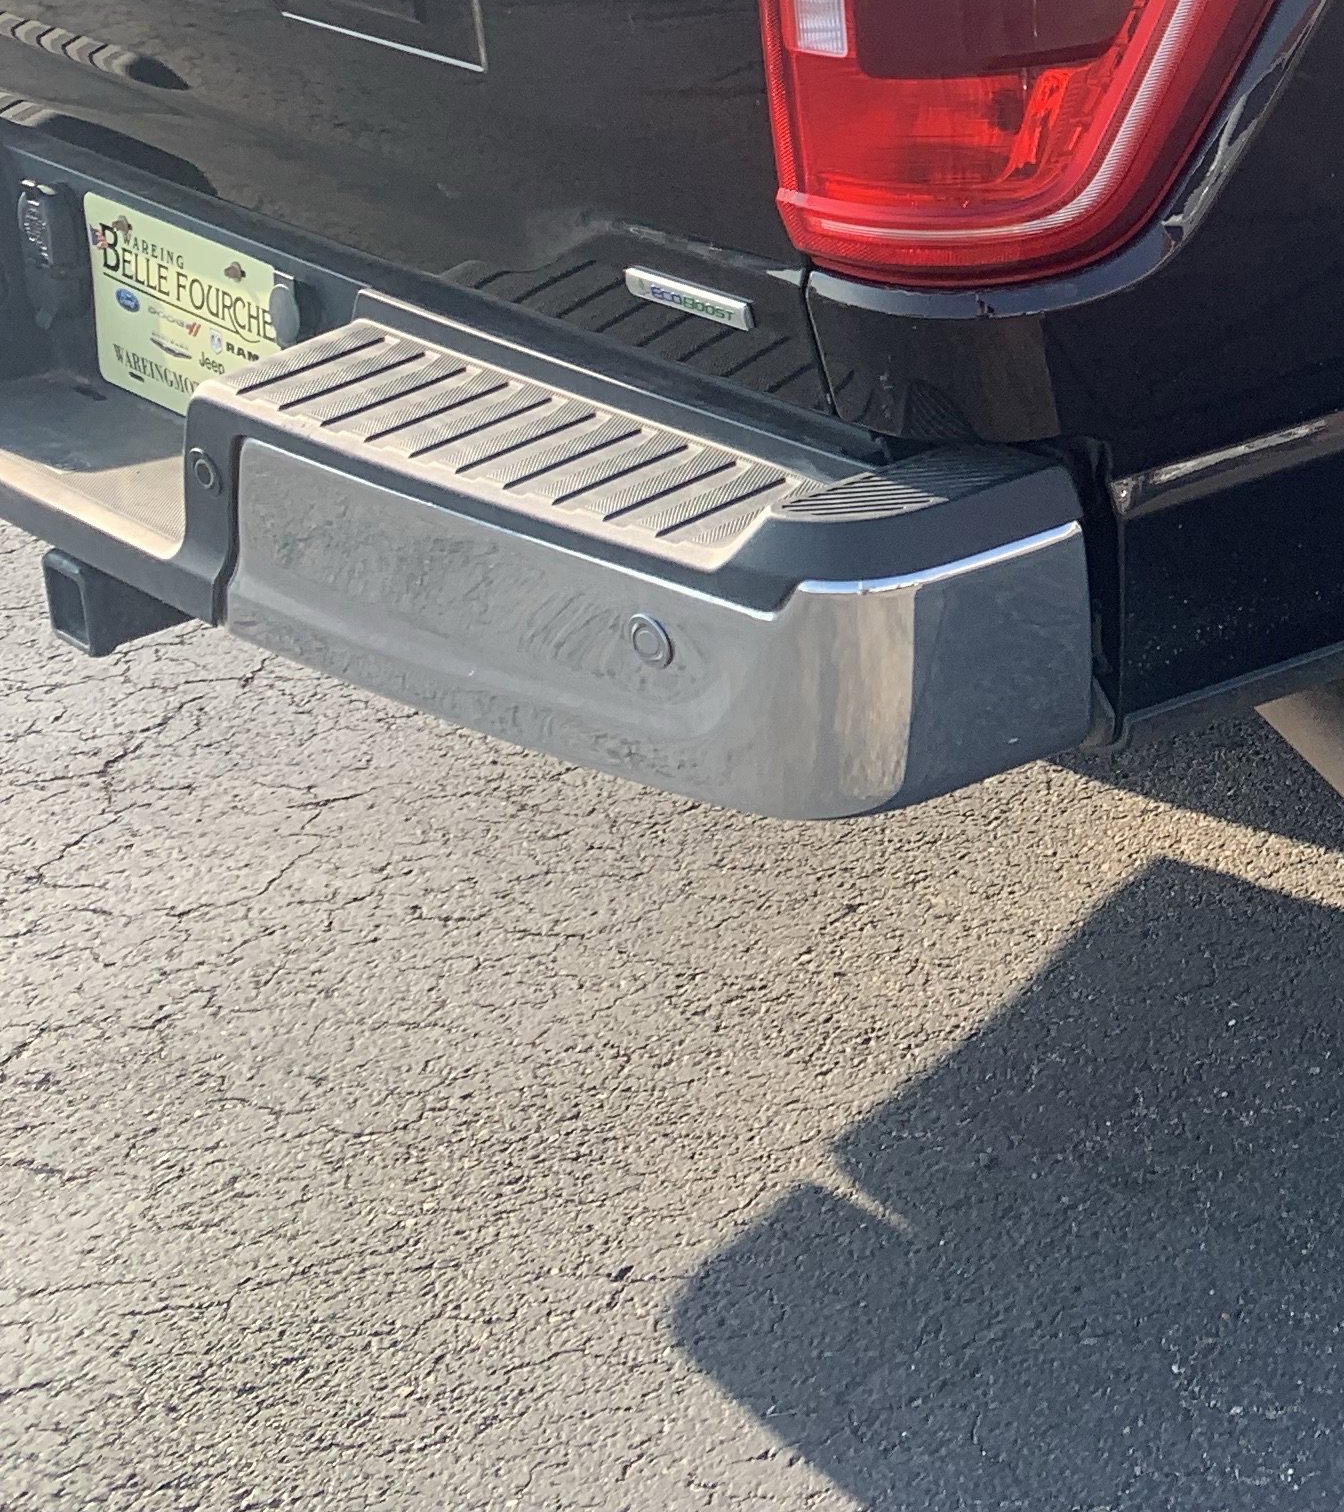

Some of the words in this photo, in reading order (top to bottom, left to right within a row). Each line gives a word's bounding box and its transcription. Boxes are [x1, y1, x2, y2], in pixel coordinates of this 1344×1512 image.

[123, 230, 185, 269] WAREING
[99, 222, 170, 297] BELLE
[176, 271, 277, 343] FOURCHE
[199, 351, 225, 375] Jeep
[226, 342, 259, 362] RAM
